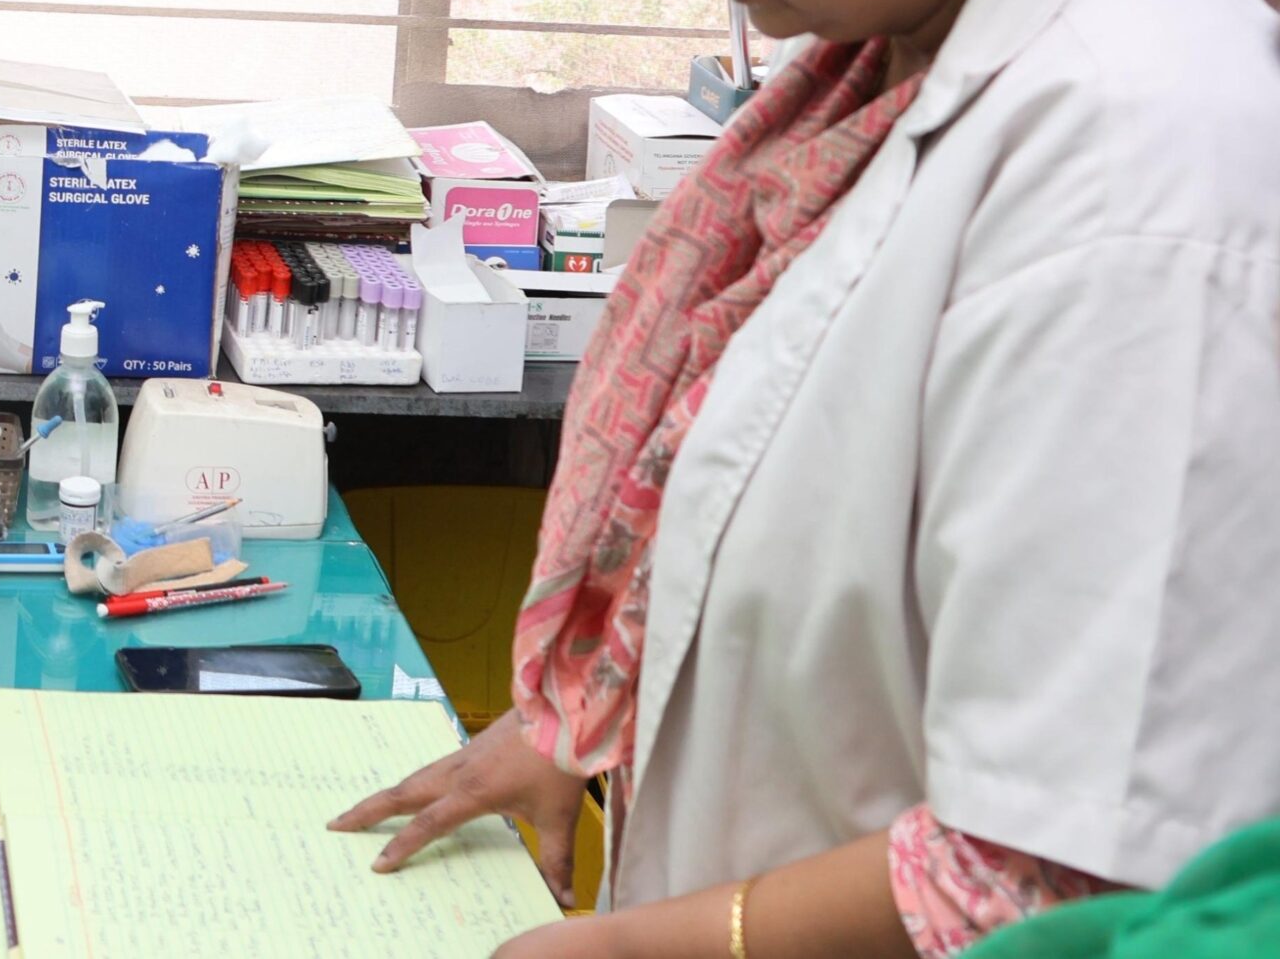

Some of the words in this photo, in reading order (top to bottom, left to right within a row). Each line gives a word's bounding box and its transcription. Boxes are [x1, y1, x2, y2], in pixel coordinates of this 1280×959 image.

[56, 139, 96, 149] STERILE
[97, 140, 127, 150] LATEX
[107, 178, 137, 190] ATEX
[48, 191, 108, 204] SURGICAL
[110, 193, 150, 205] GLOVE
[123, 359, 145, 372] QTY
[152, 360, 165, 371] 50
[167, 359, 193, 372] Pairs
[195, 471, 210, 490] A
[219, 471, 231, 490] P
